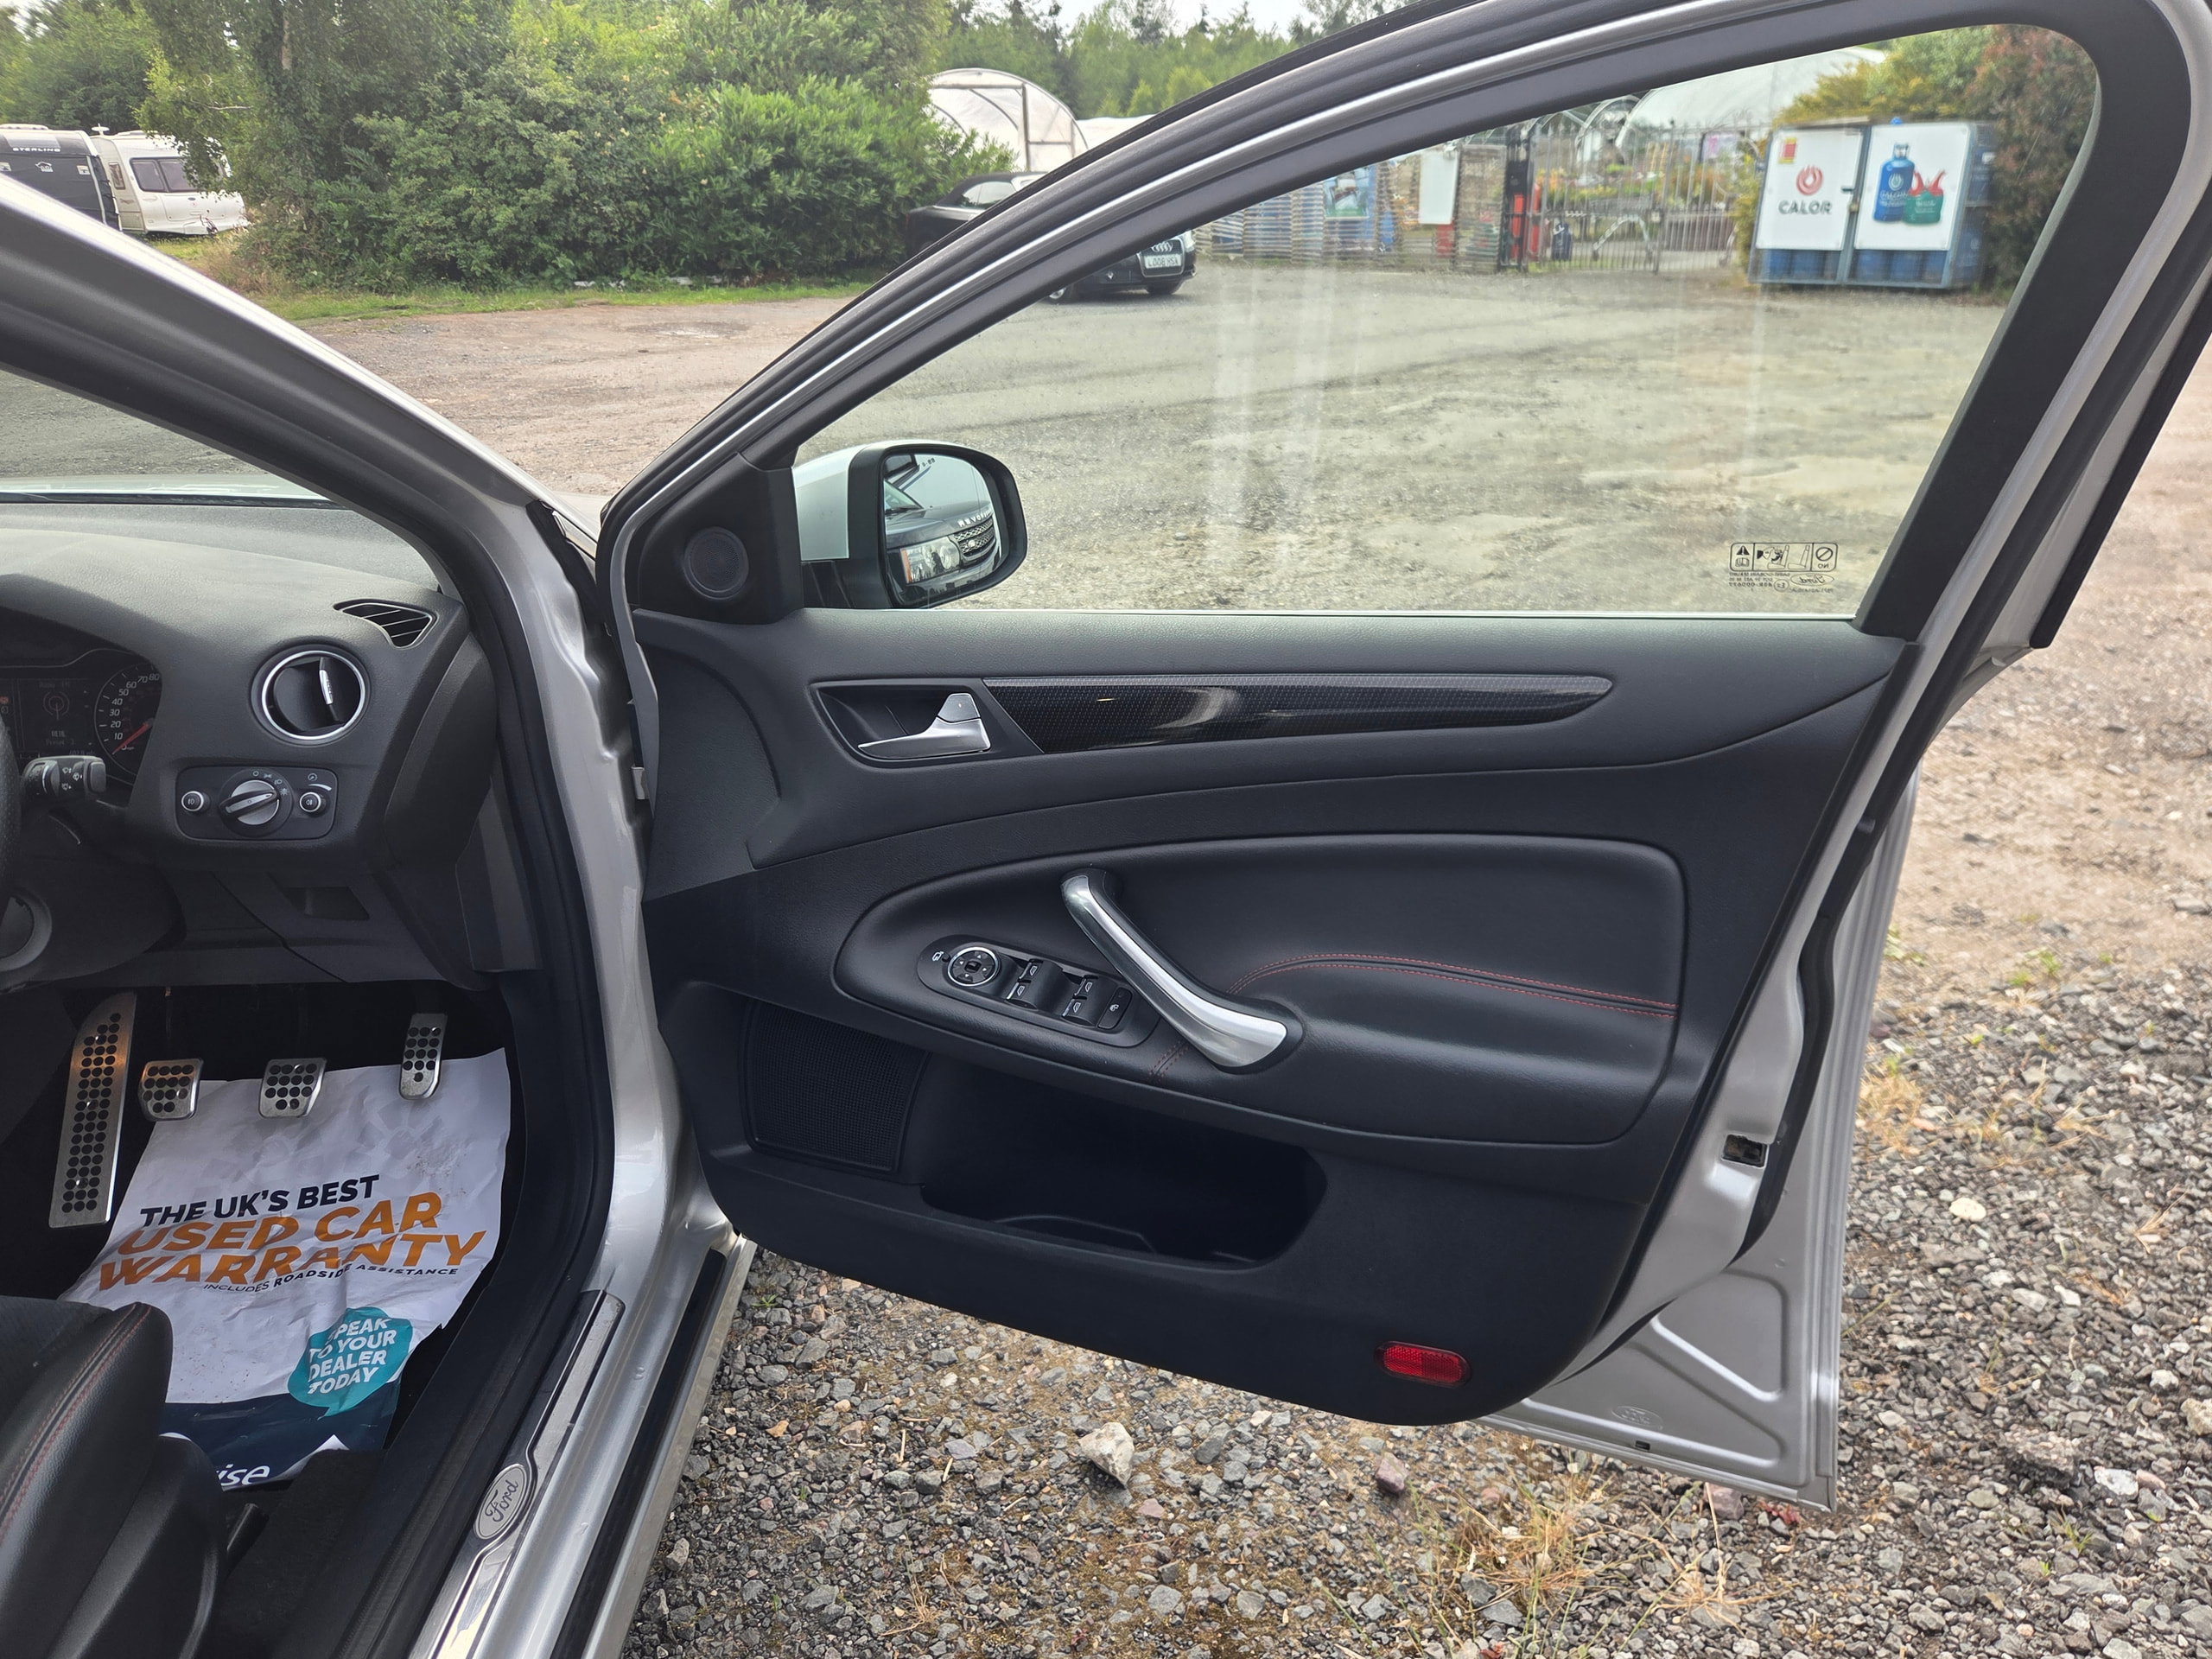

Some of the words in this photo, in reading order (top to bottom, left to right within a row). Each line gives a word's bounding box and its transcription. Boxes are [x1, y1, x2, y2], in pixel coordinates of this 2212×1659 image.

[1778, 200, 1832, 215] CALOR
[140, 1200, 207, 1227] THE
[213, 1188, 290, 1220] UK'S
[298, 1174, 380, 1205] BEST
[117, 1215, 299, 1256] USED
[314, 1192, 443, 1243] CAR
[98, 1230, 487, 1292] WARRANTY
[203, 1281, 270, 1293] INCLUDES
[273, 1263, 352, 1288] ROADSIDE
[355, 1263, 460, 1276] ASSISTANCE
[308, 1344, 334, 1363] TO
[337, 1330, 397, 1354] YOUR
[308, 1350, 387, 1382] DEALER
[308, 1367, 378, 1395] TODAY
[216, 1464, 270, 1485] ise
[485, 1479, 519, 1523] Ford
